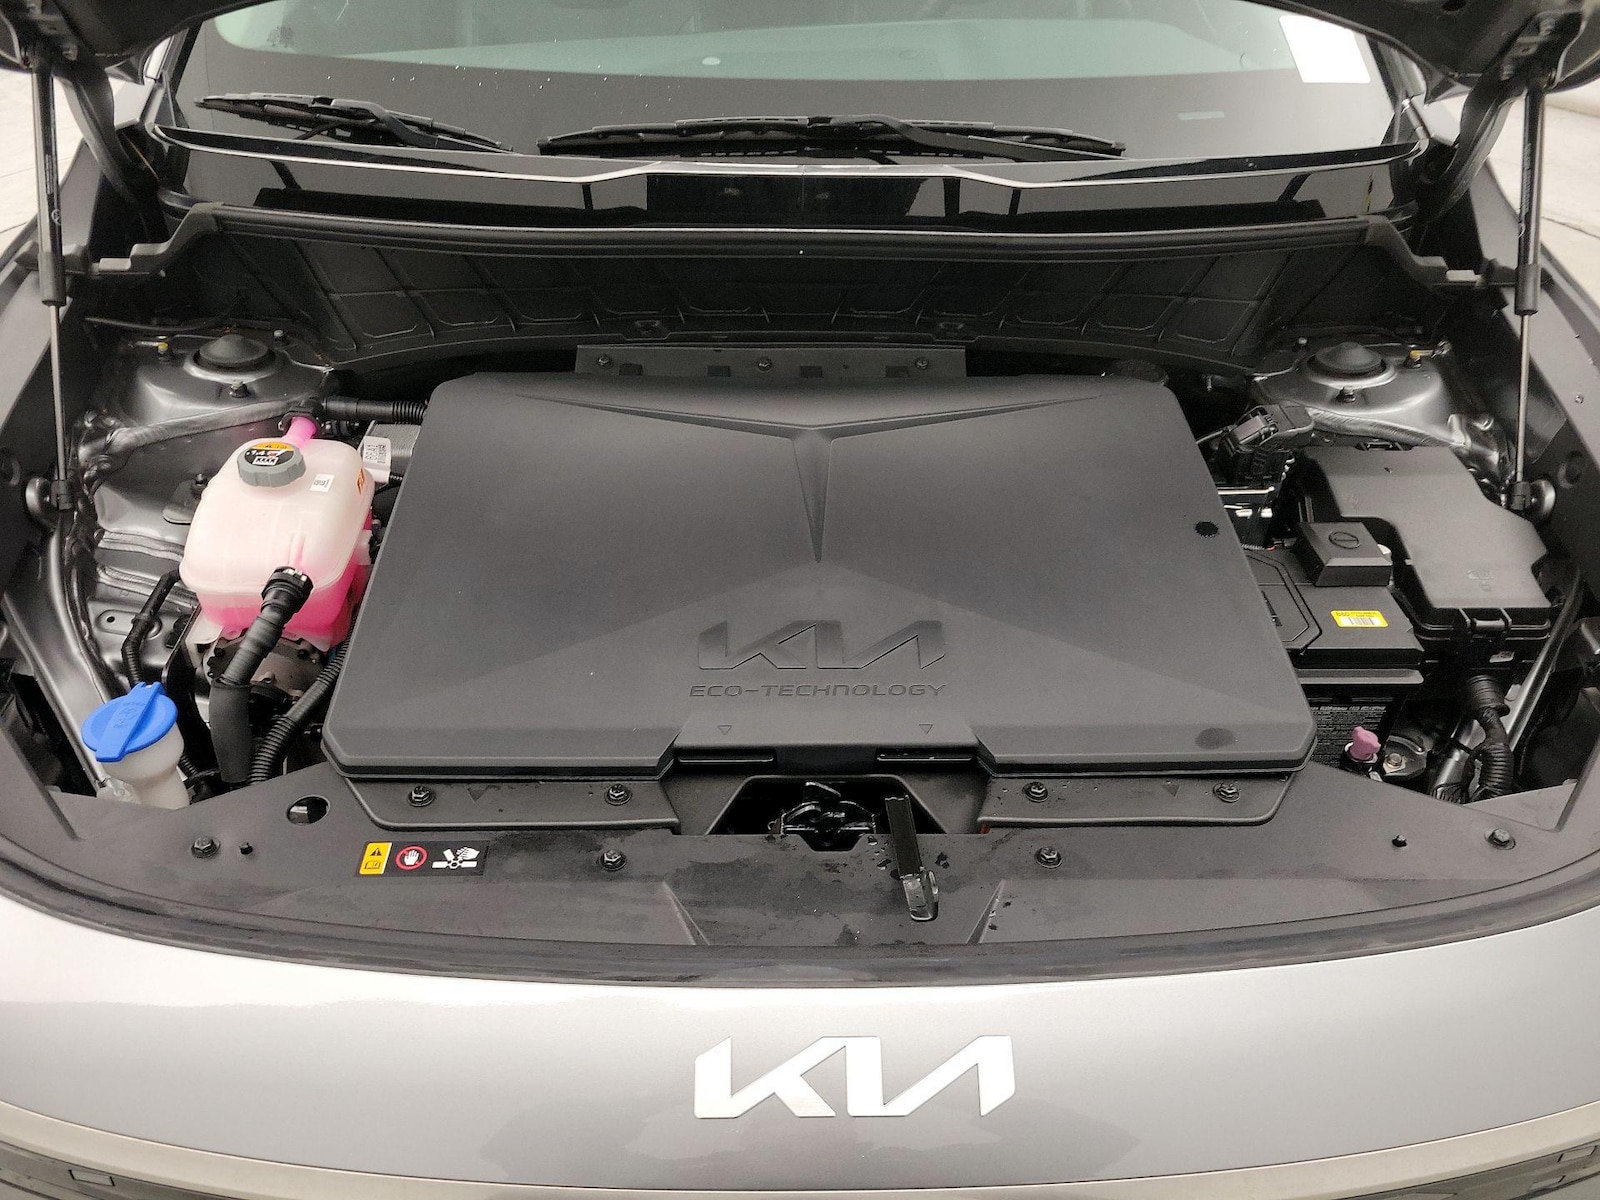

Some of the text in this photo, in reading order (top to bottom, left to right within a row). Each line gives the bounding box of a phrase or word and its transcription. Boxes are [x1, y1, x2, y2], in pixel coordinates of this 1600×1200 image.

[698, 620, 946, 670] KIA
[689, 684, 947, 697] ECO-TECHNOLOGY
[694, 1035, 1016, 1119] KIA
